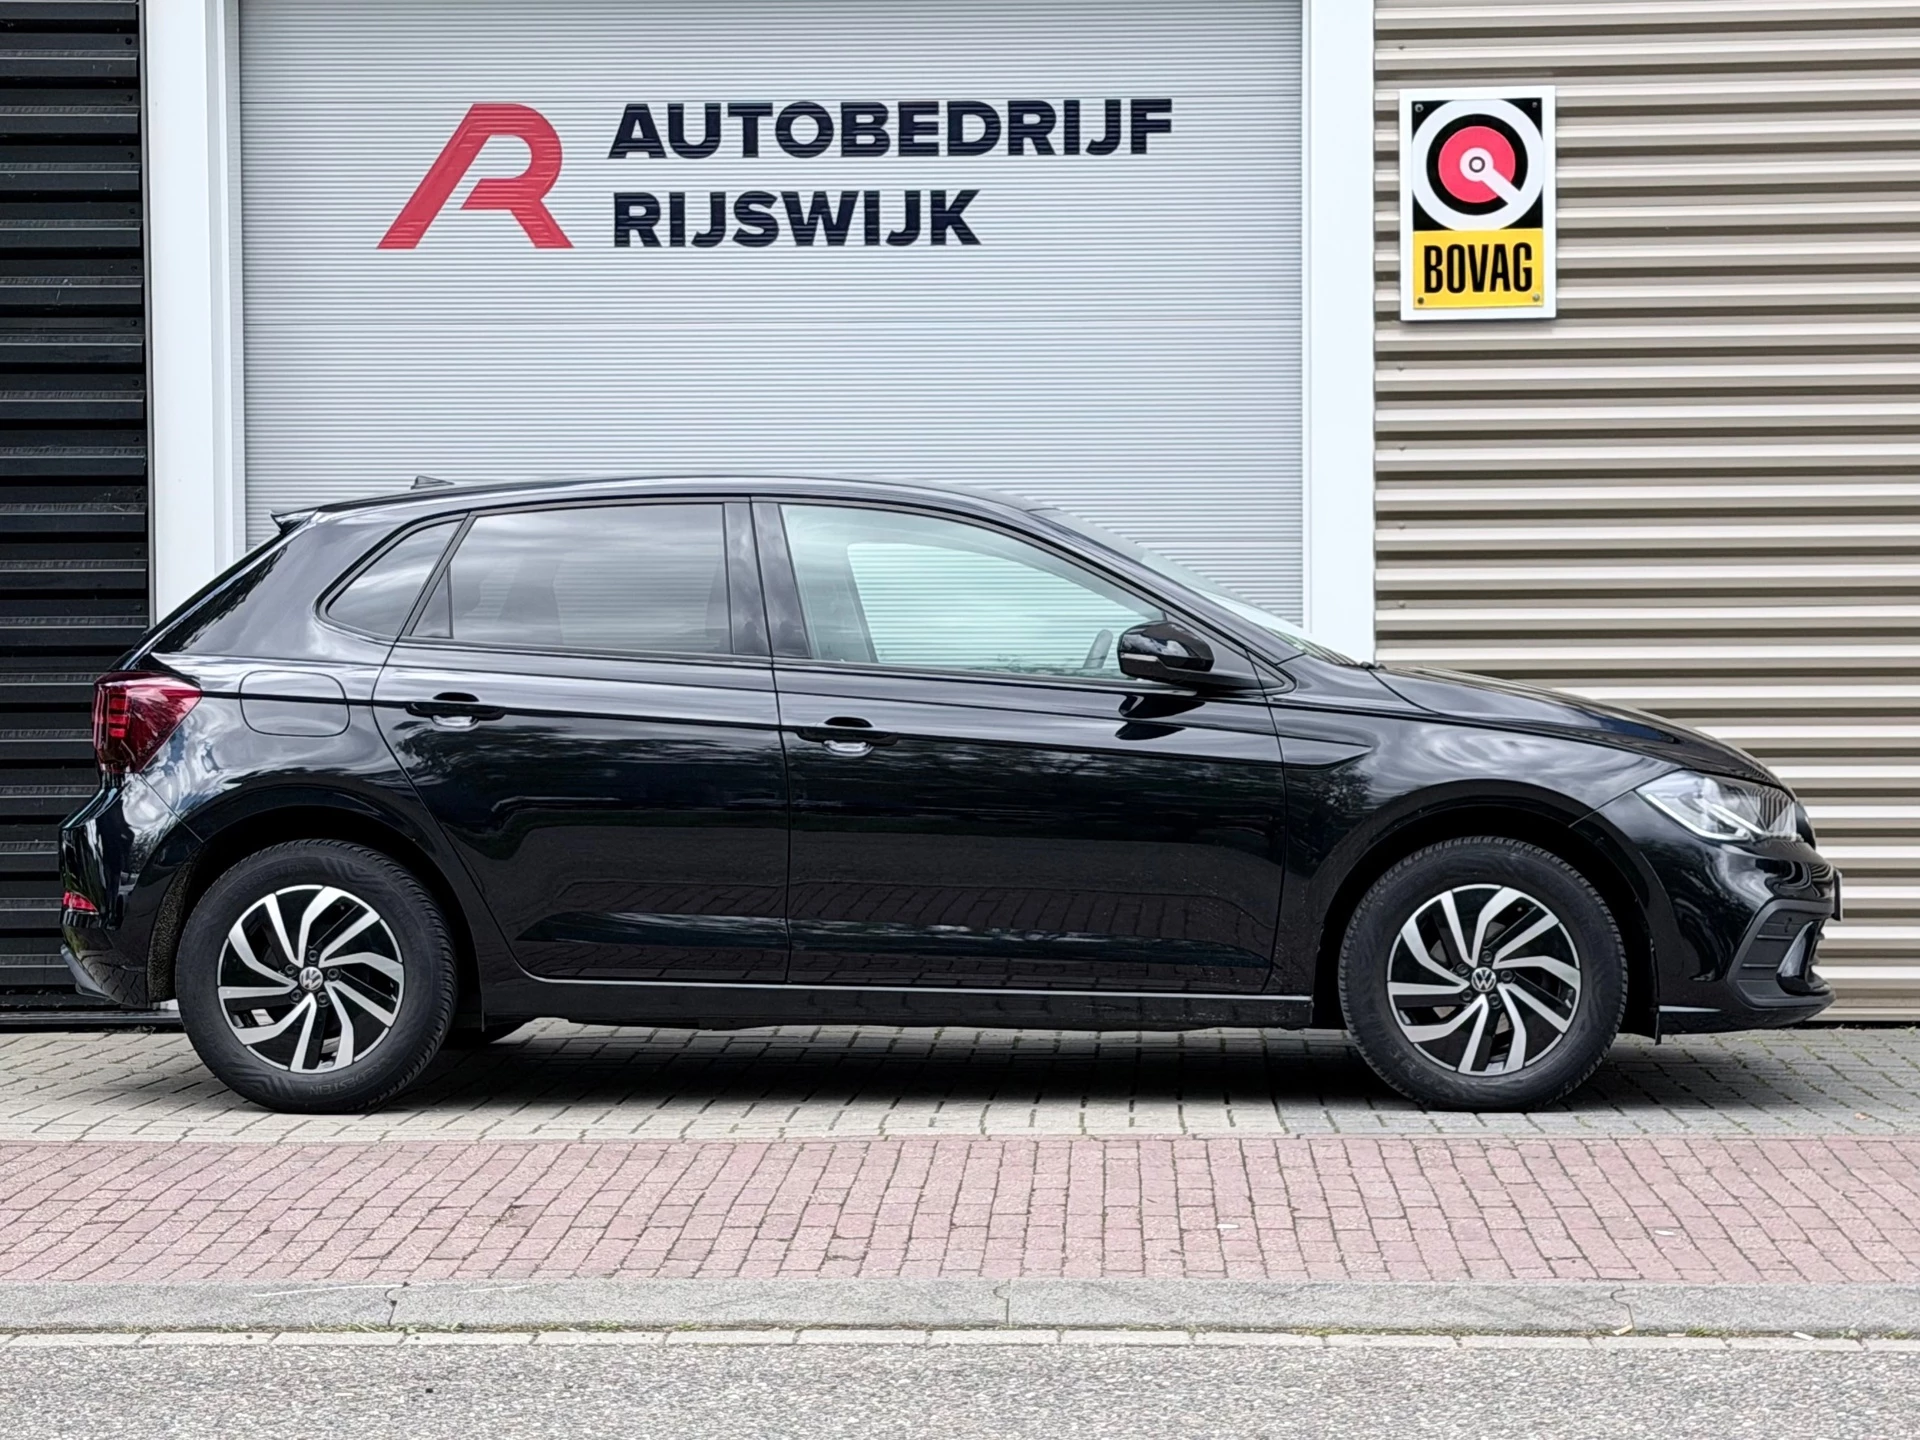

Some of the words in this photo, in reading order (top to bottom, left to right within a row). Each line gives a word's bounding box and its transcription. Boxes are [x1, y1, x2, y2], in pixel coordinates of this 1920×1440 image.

[607, 98, 1173, 160] AUTOBEDRIJF
[613, 189, 982, 249] RIJSWIJK
[1423, 241, 1533, 294] BOVAG
